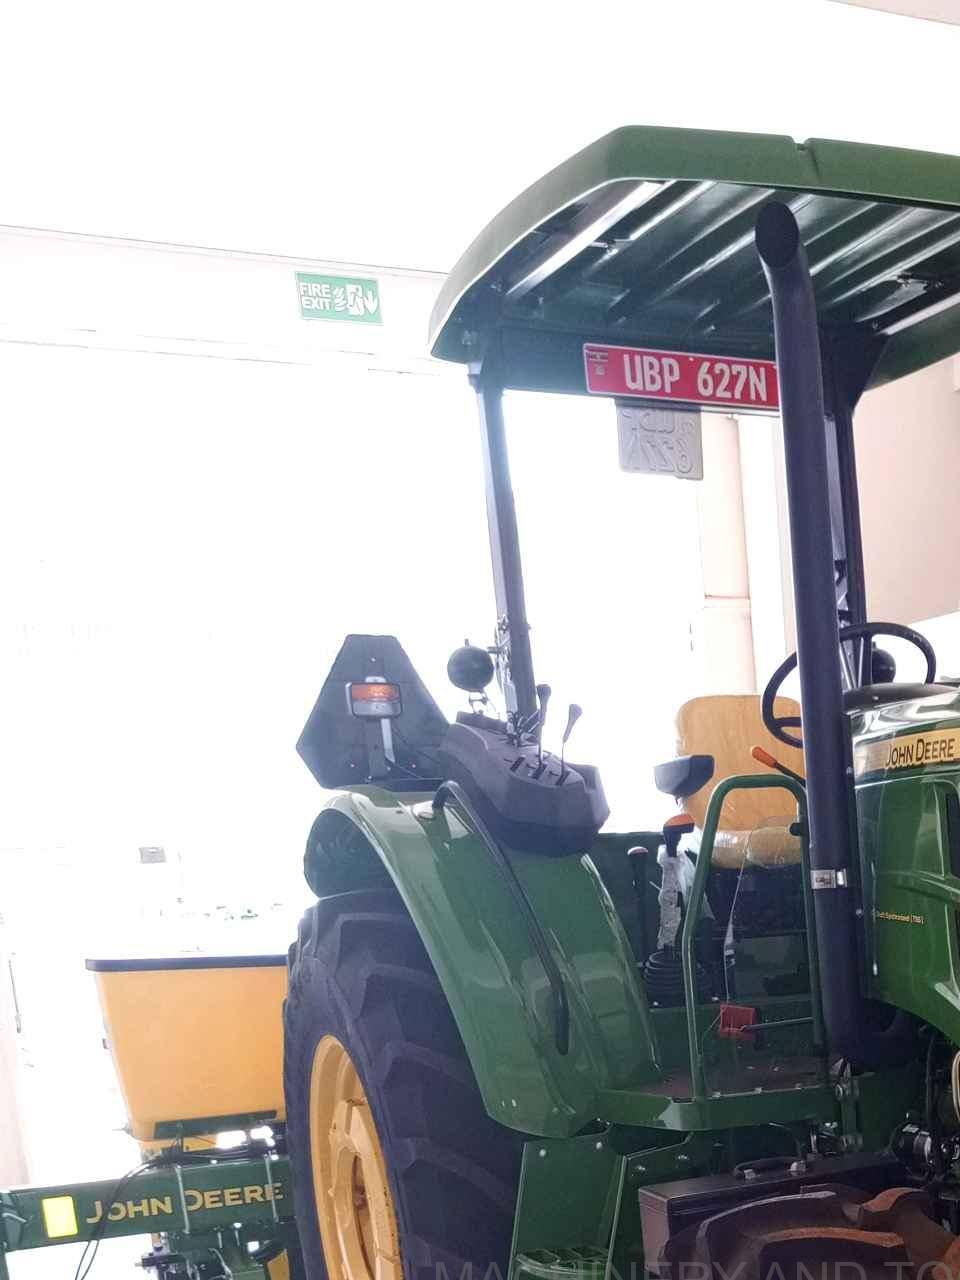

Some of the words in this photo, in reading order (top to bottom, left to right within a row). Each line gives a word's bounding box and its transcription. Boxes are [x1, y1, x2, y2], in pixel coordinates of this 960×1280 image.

[300, 282, 331, 297] FIRE
[302, 297, 331, 310] EXIT
[623, 354, 680, 393] UBP
[697, 361, 767, 401] 627N
[885, 744, 914, 768] JOHN
[915, 738, 955, 762] DEERE
[86, 1196, 173, 1224] JOHN
[183, 1183, 284, 1212] DEERE
